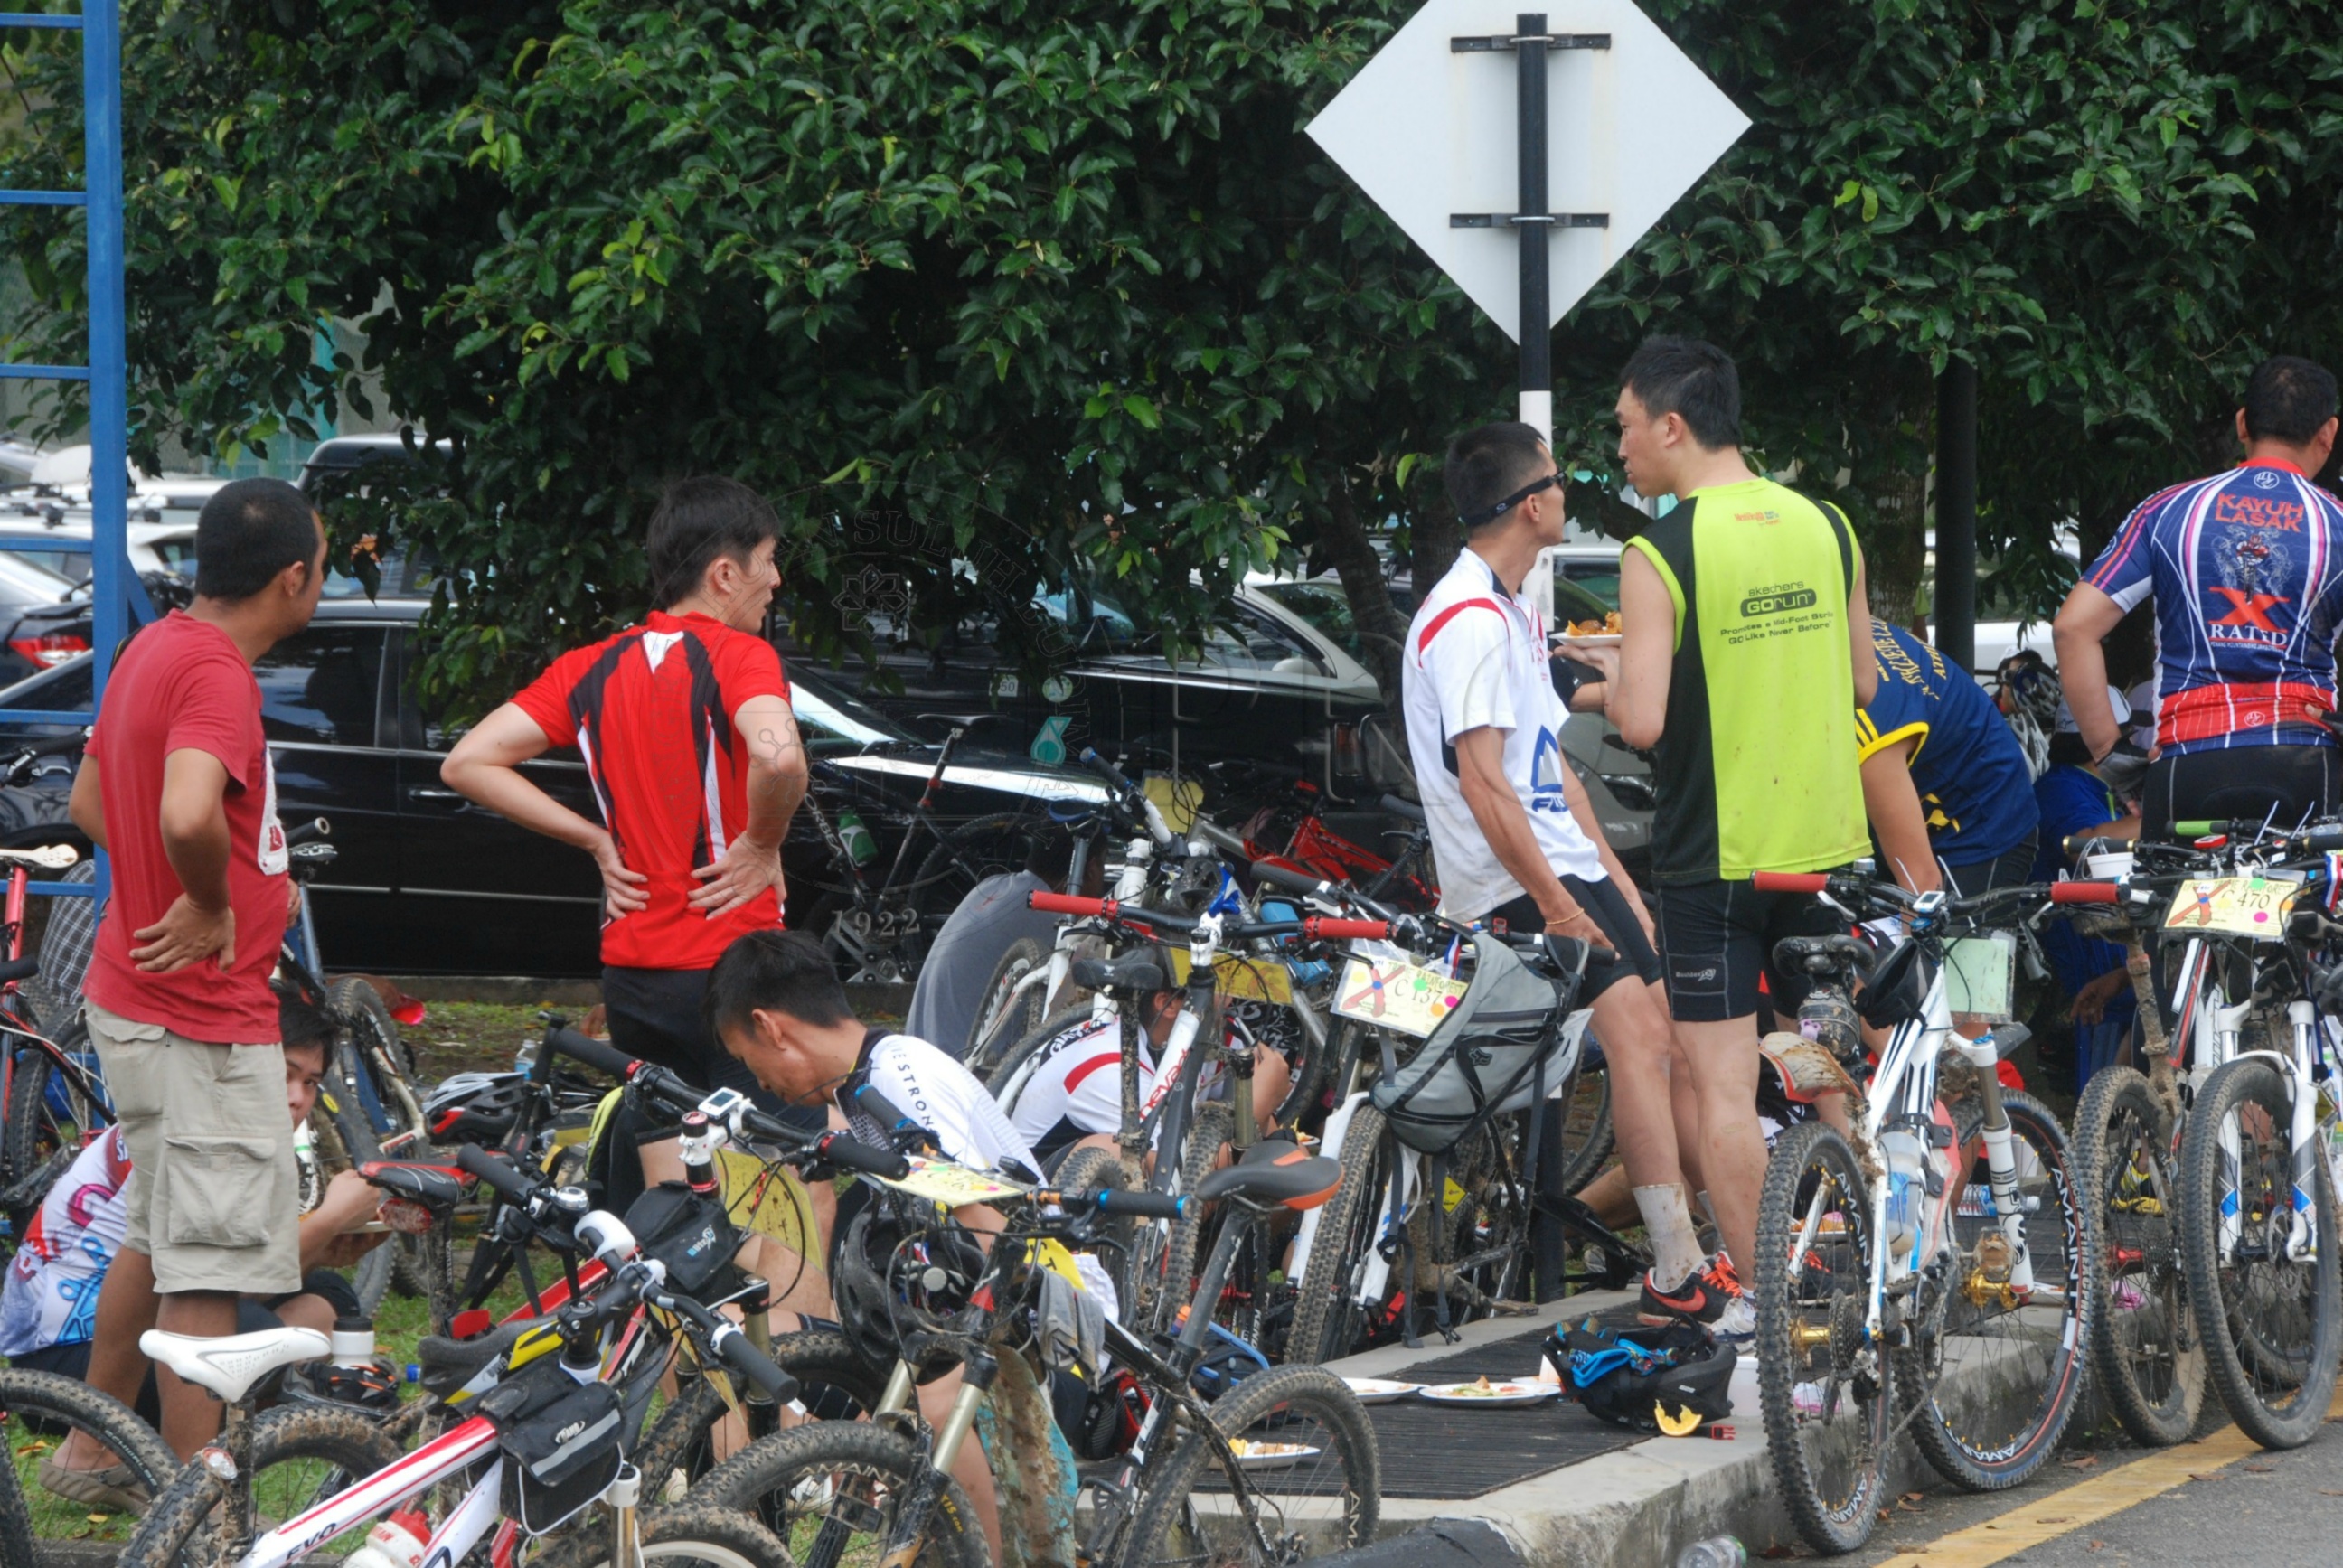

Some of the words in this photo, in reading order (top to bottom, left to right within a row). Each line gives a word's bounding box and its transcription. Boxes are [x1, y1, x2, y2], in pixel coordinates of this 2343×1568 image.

[2217, 493, 2305, 518] KAYUH
[2216, 507, 2303, 533] LASAK
[1748, 580, 1804, 597] skechers
[1745, 631, 1765, 641] Like
[2210, 624, 2288, 646] RATED
[2237, 893, 2270, 909] 470
[1250, 1308, 1263, 1350] KEND
